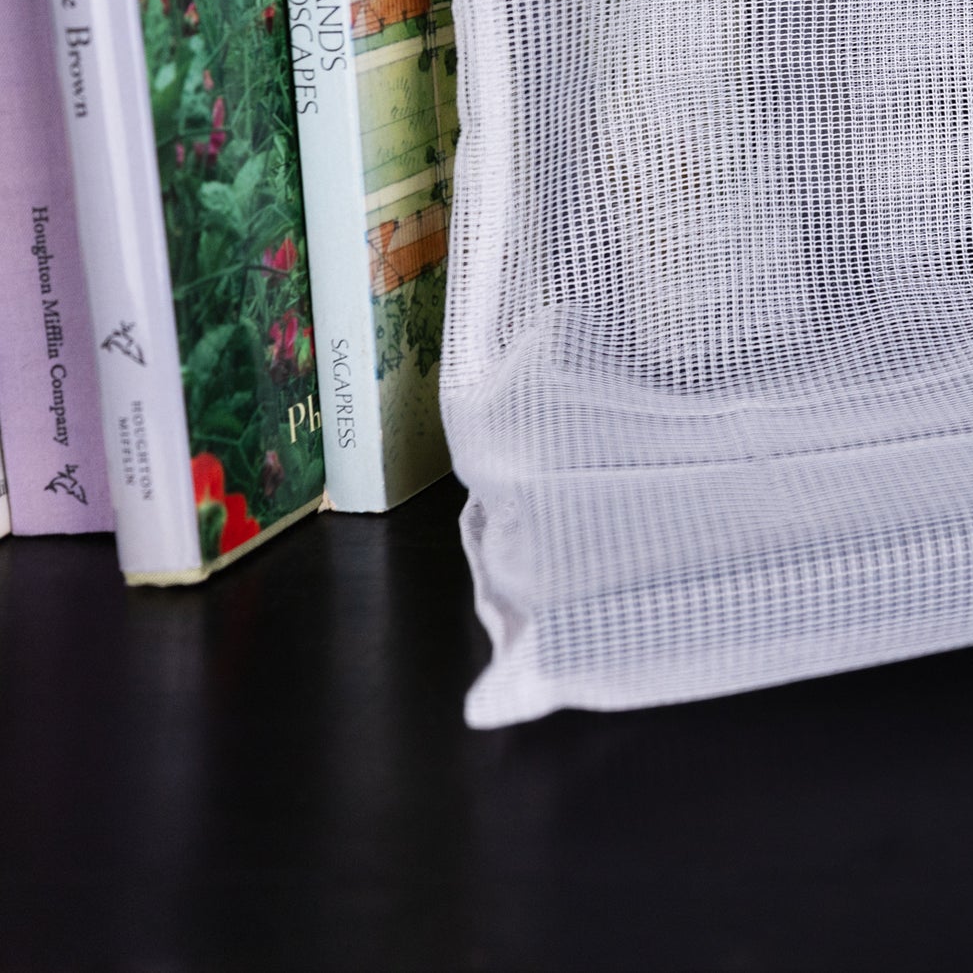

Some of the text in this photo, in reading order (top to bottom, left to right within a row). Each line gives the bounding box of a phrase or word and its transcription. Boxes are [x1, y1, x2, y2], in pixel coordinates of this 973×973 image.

[65, 25, 91, 119] Brown
[31, 206, 70, 447] Houghton Mifflin Company
[331, 337, 356, 450] SAGAPRESS
